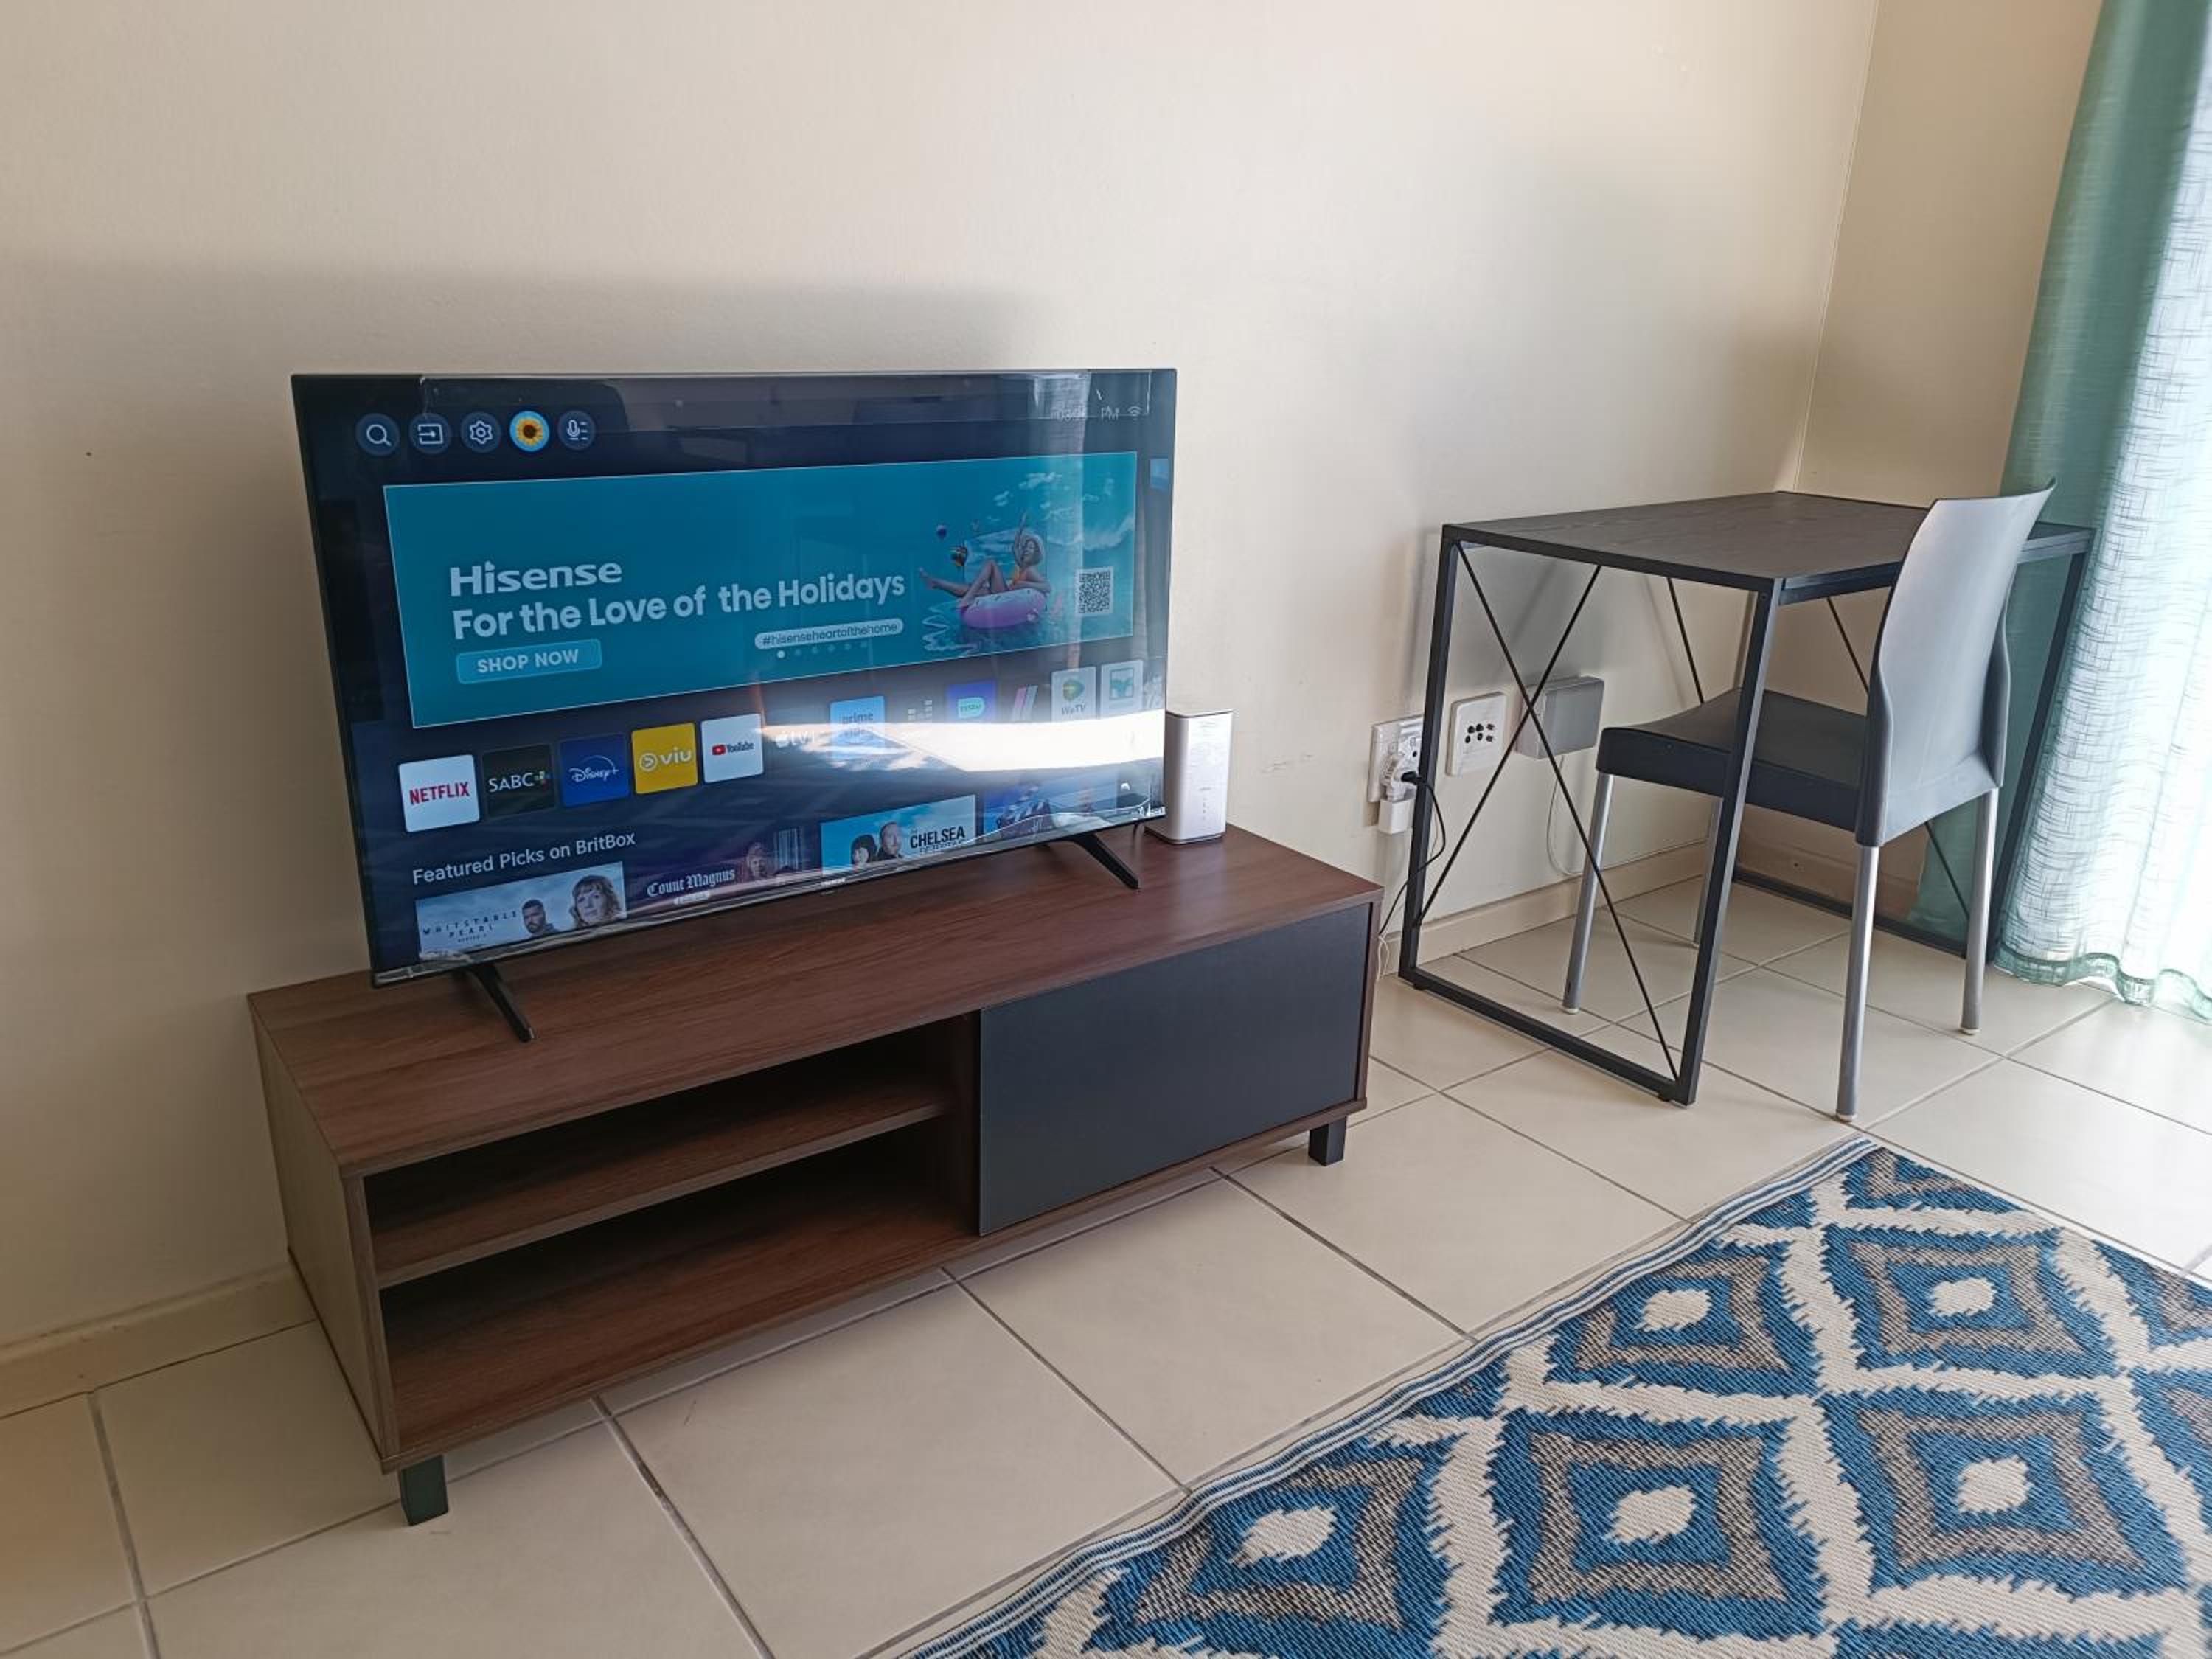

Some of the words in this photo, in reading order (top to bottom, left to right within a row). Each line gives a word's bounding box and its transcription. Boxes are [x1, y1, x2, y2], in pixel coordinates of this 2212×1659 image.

[450, 561, 622, 597] Hisense
[453, 609, 514, 639] For
[519, 602, 582, 633] the
[588, 597, 667, 626] Love
[673, 585, 706, 617] of
[718, 583, 772, 612] the
[778, 573, 905, 605] Holidays
[762, 623, 897, 646] #hisenseheartofthehome
[477, 654, 528, 673] SHOP
[535, 649, 579, 668] NOW
[726, 740, 754, 753] YouTube
[409, 782, 470, 805] NETFLIX
[910, 825, 965, 849] CHELSEA
[412, 855, 493, 885] Featured
[499, 848, 545, 869] Picks
[549, 846, 570, 859] on
[575, 832, 636, 855] BritBox
[647, 880, 685, 897] Count
[686, 869, 736, 889] Magnus
